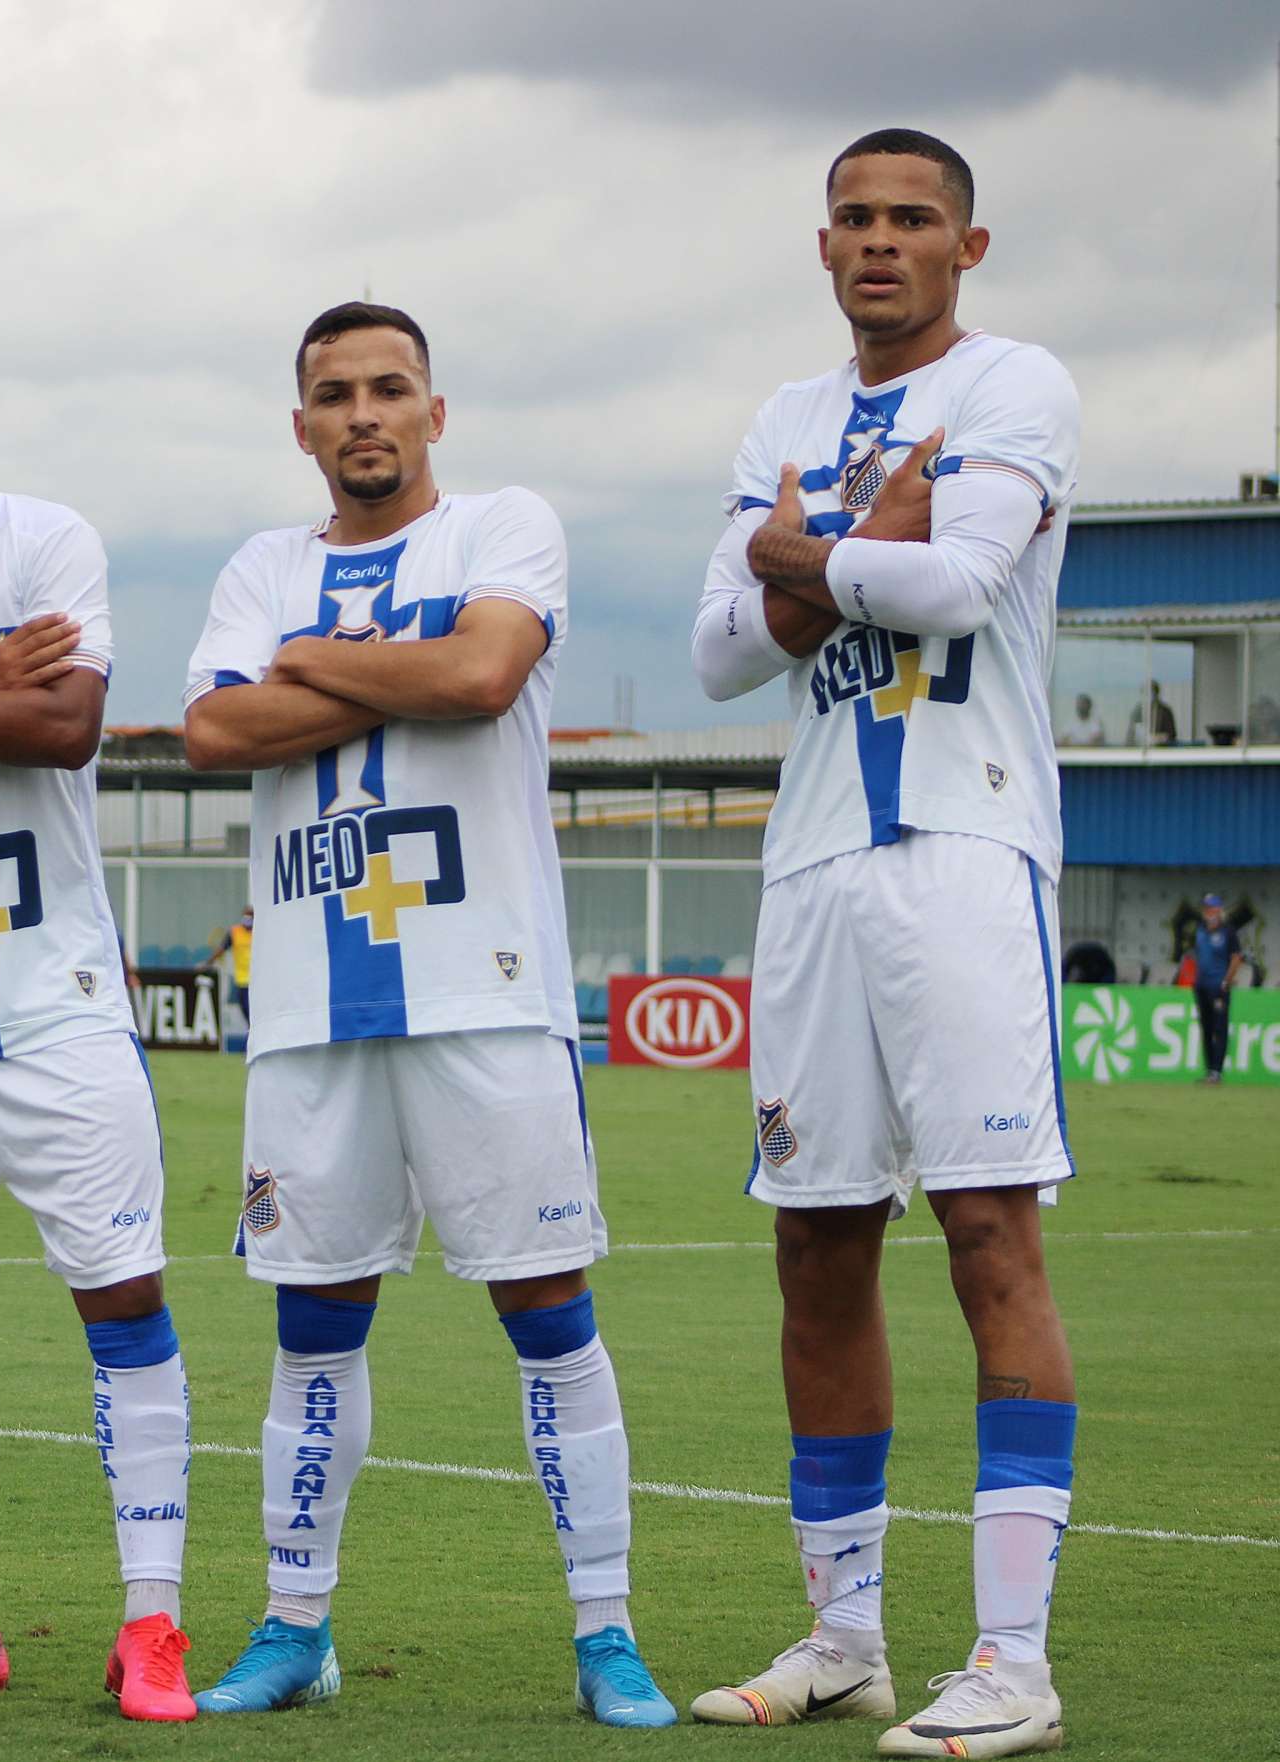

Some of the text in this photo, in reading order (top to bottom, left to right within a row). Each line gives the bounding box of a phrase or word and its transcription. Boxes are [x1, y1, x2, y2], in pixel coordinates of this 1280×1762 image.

[336, 563, 388, 581] Karilu
[646, 996, 724, 1048] KIA
[1147, 1002, 1280, 1073] Sire
[538, 1200, 582, 1223] Karilu
[94, 1392, 118, 1479] SANTA
[116, 1502, 186, 1522] Karilu
[288, 1445, 334, 1530] SANTA
[535, 1446, 575, 1532] SANTA
